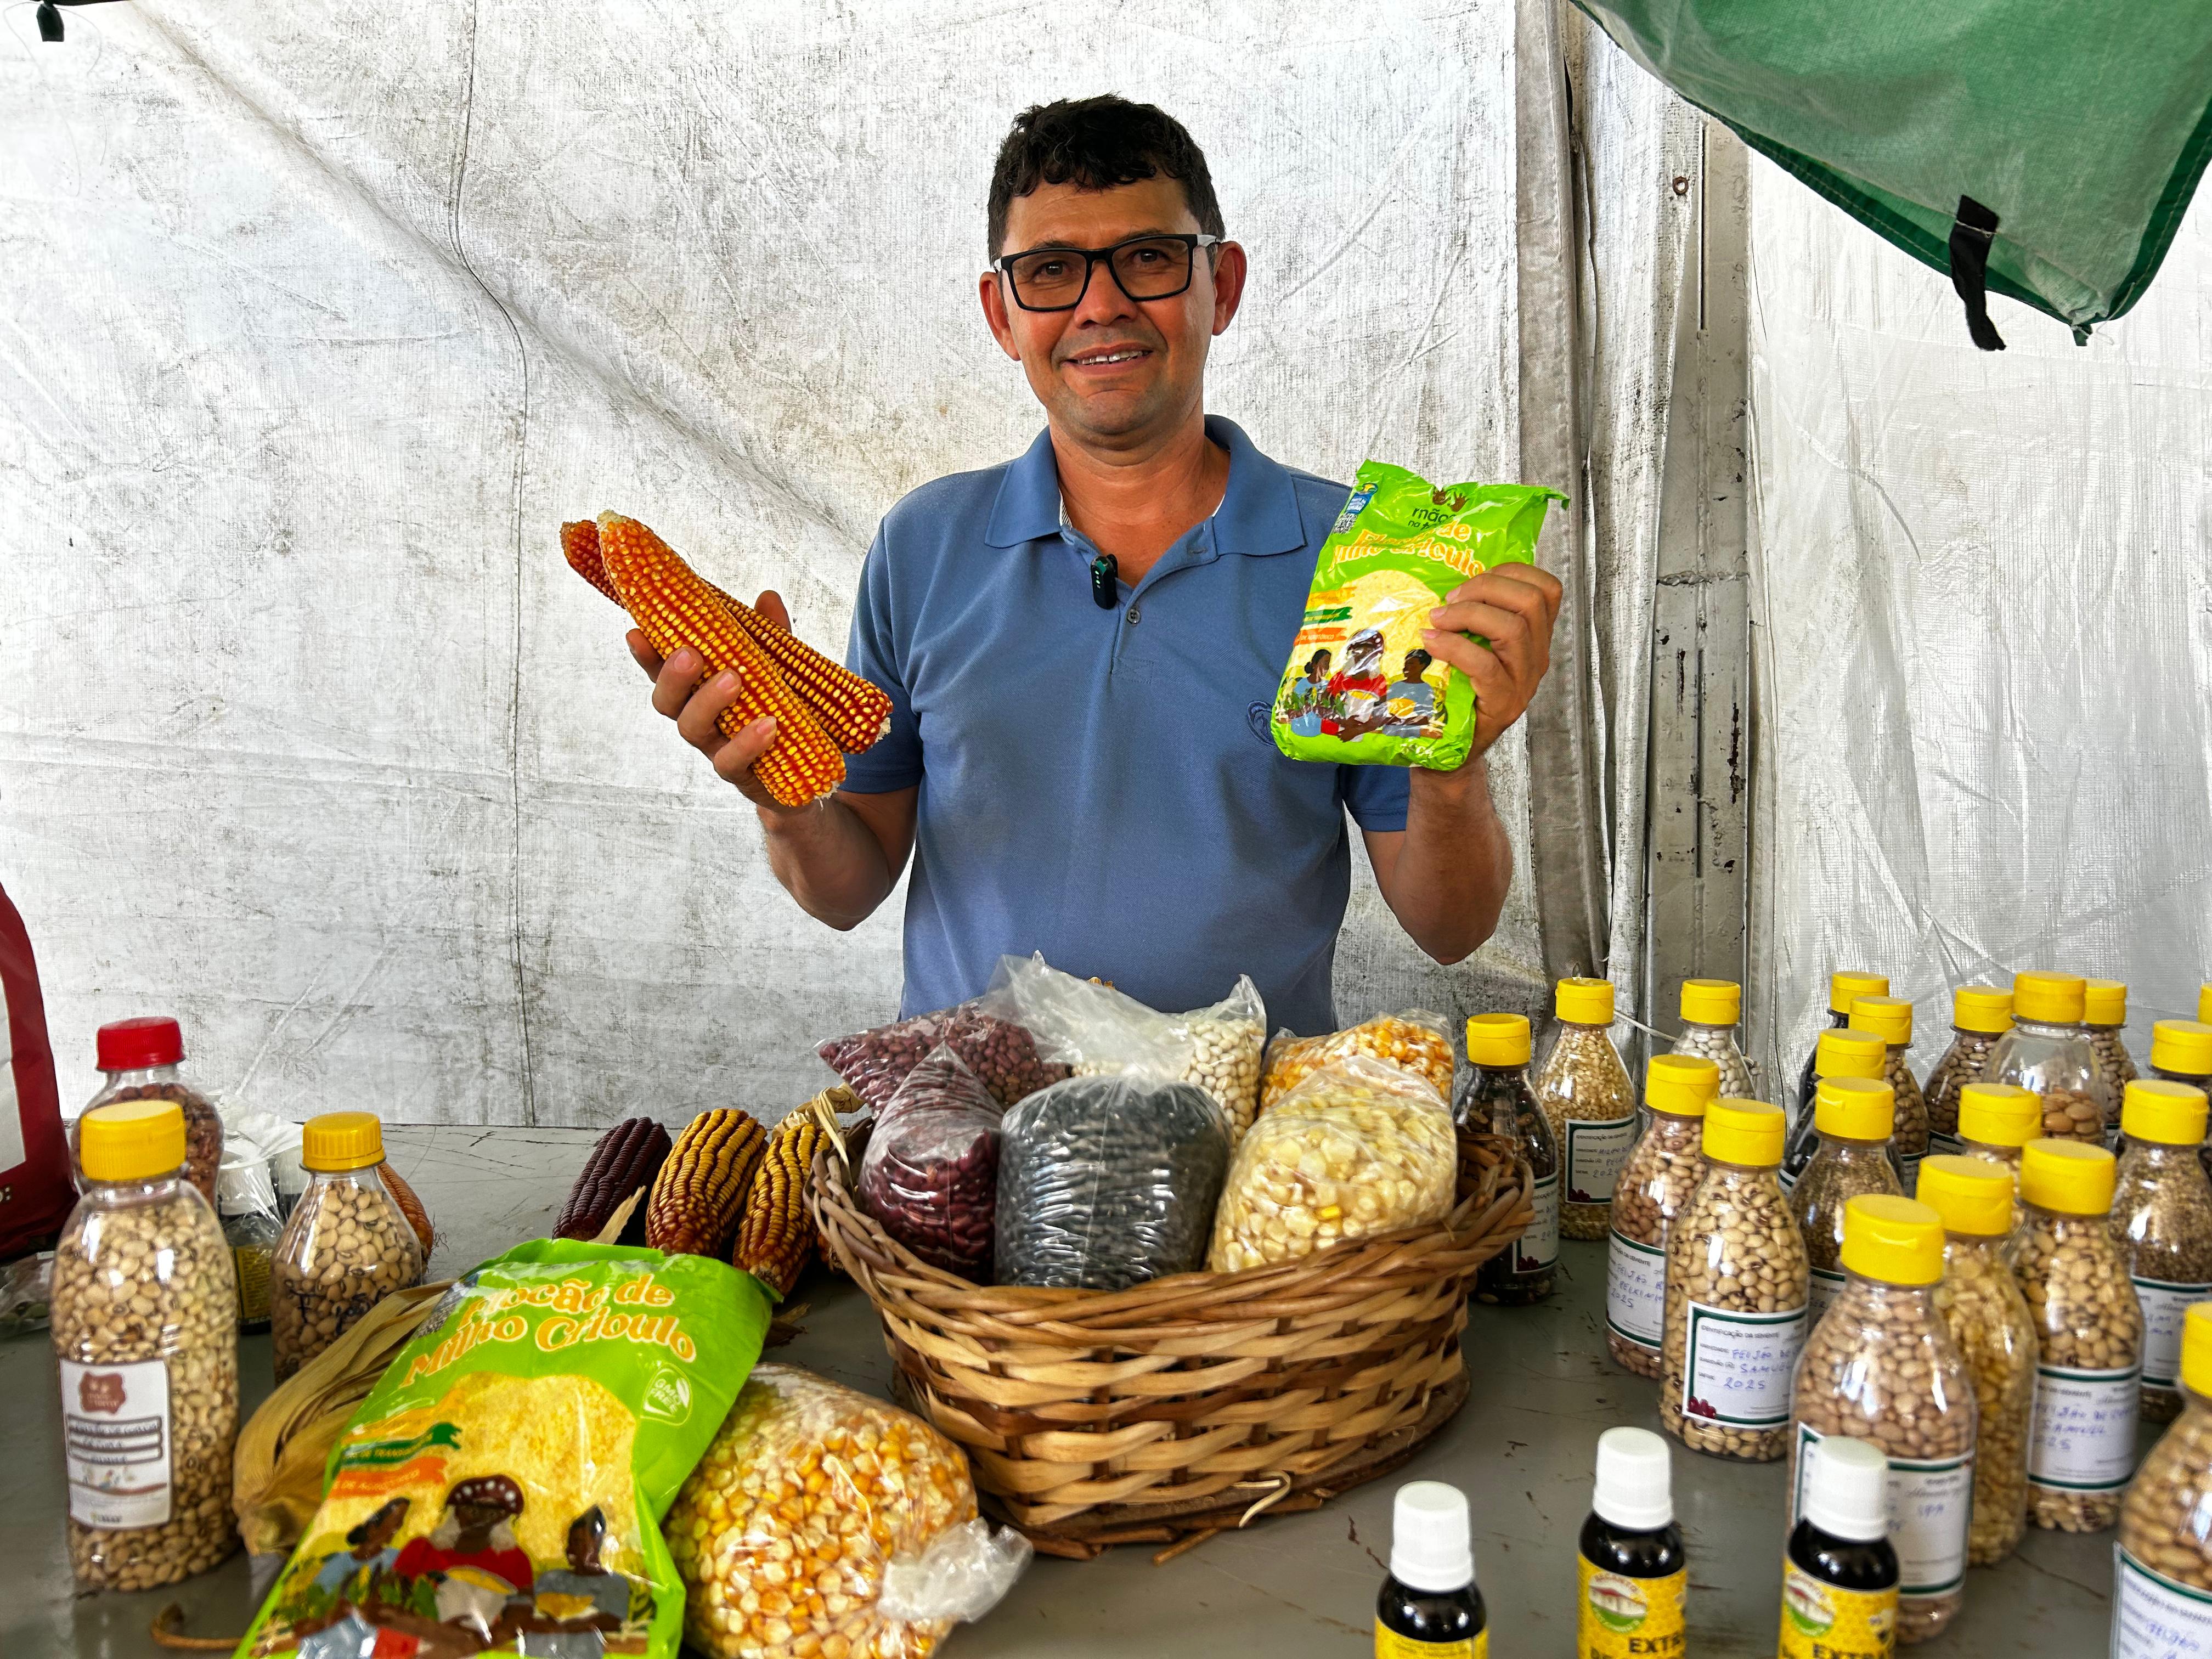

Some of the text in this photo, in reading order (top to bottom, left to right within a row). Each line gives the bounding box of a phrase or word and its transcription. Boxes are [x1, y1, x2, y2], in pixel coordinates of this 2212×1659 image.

[1407, 520, 1420, 528] na
[1436, 519, 1472, 543] de
[613, 1273, 675, 1307] de
[398, 1306, 697, 1390] Milho Crioulo
[1723, 1376, 1767, 1390] 2025
